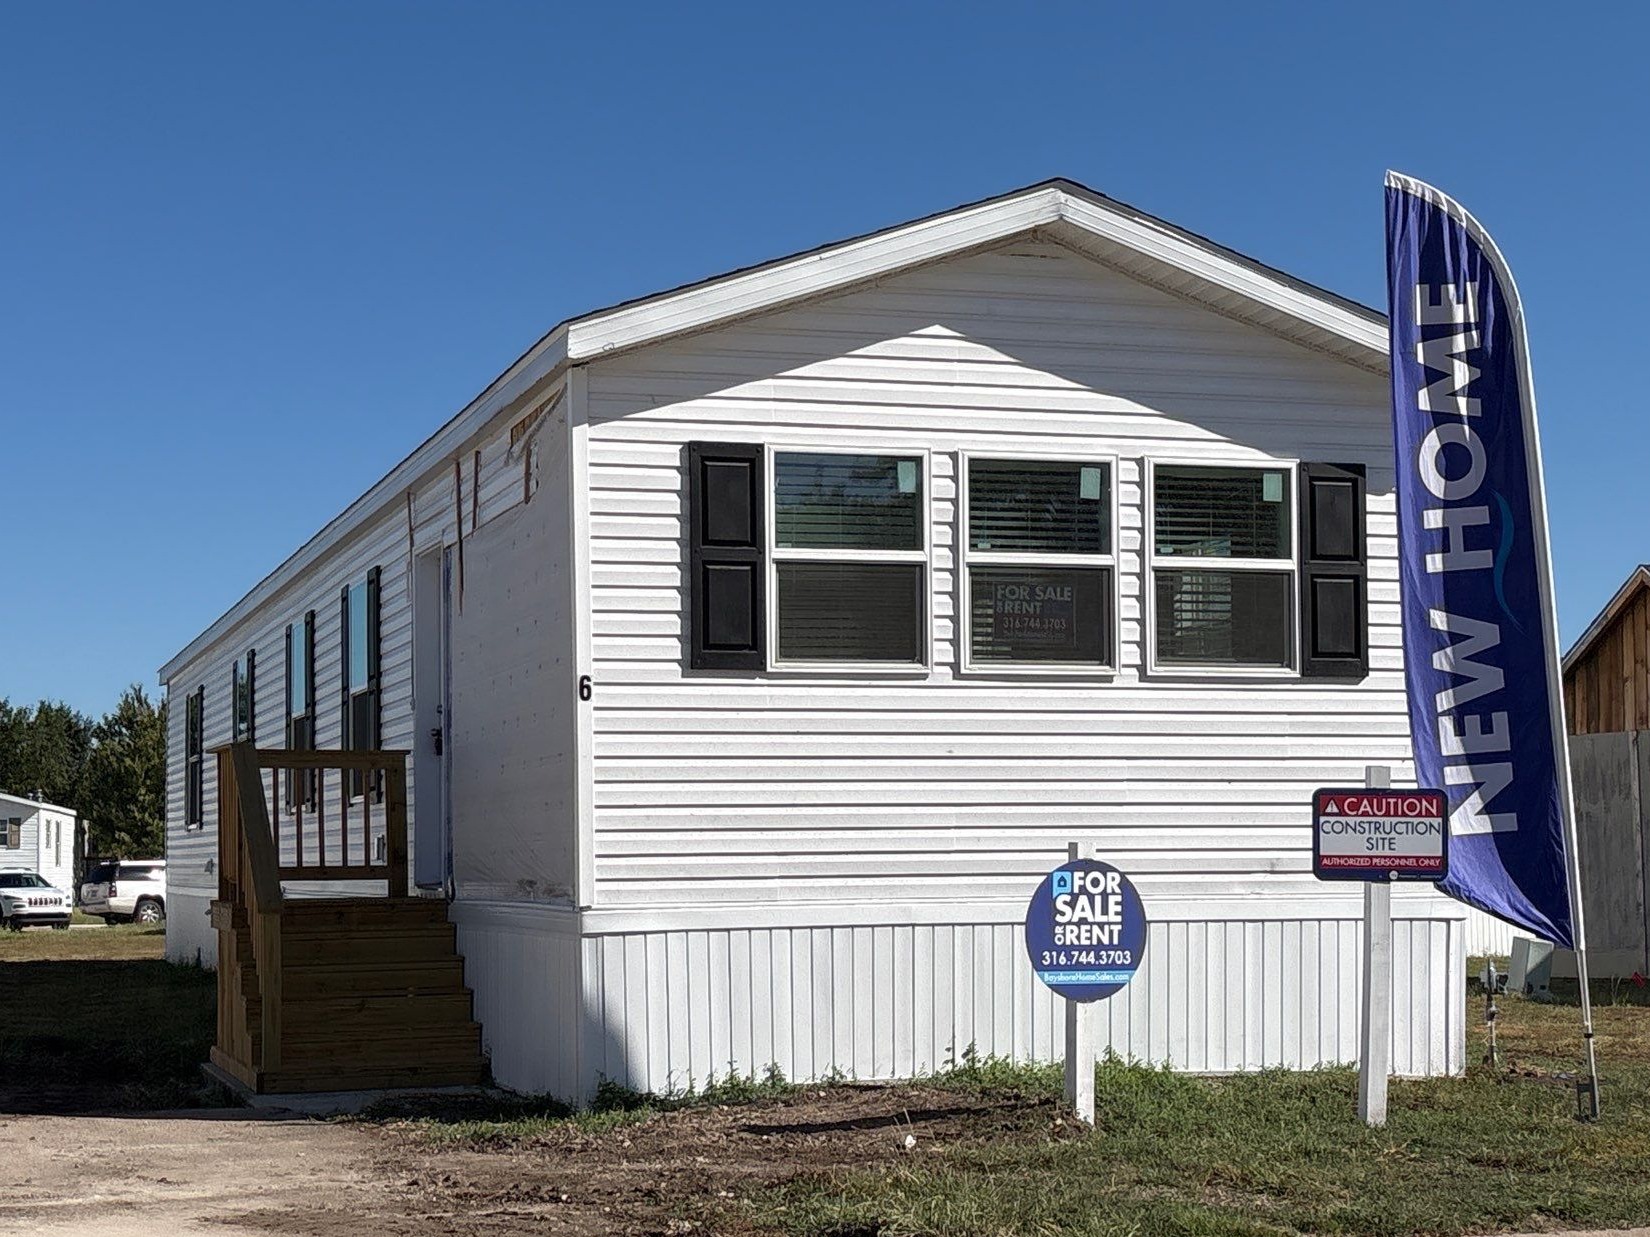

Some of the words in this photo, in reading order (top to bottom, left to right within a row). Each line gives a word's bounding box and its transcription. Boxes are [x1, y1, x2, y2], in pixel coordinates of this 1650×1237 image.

[1416, 281, 1494, 574] HOME
[997, 584, 1030, 600] FOR
[1035, 585, 1072, 601] SALE
[1004, 601, 1042, 614] RENT
[579, 675, 591, 701] 6
[1429, 608, 1518, 836] NEW
[1343, 798, 1437, 816] CAUTION
[1321, 820, 1440, 835] CONSTRUCTION
[1366, 837, 1396, 851] SITE
[1322, 858, 1371, 866] AUTHORIZED
[1372, 858, 1418, 867] PERSONNEL
[1419, 858, 1440, 867] ONLY
[1073, 871, 1121, 894] FOR
[1055, 894, 1122, 923] SALE
[1054, 926, 1064, 944] OR
[1065, 924, 1122, 945] RENT
[1042, 951, 1131, 965] 316.744.3703
[1044, 972, 1129, 982] BayshoreHomeSales.com
